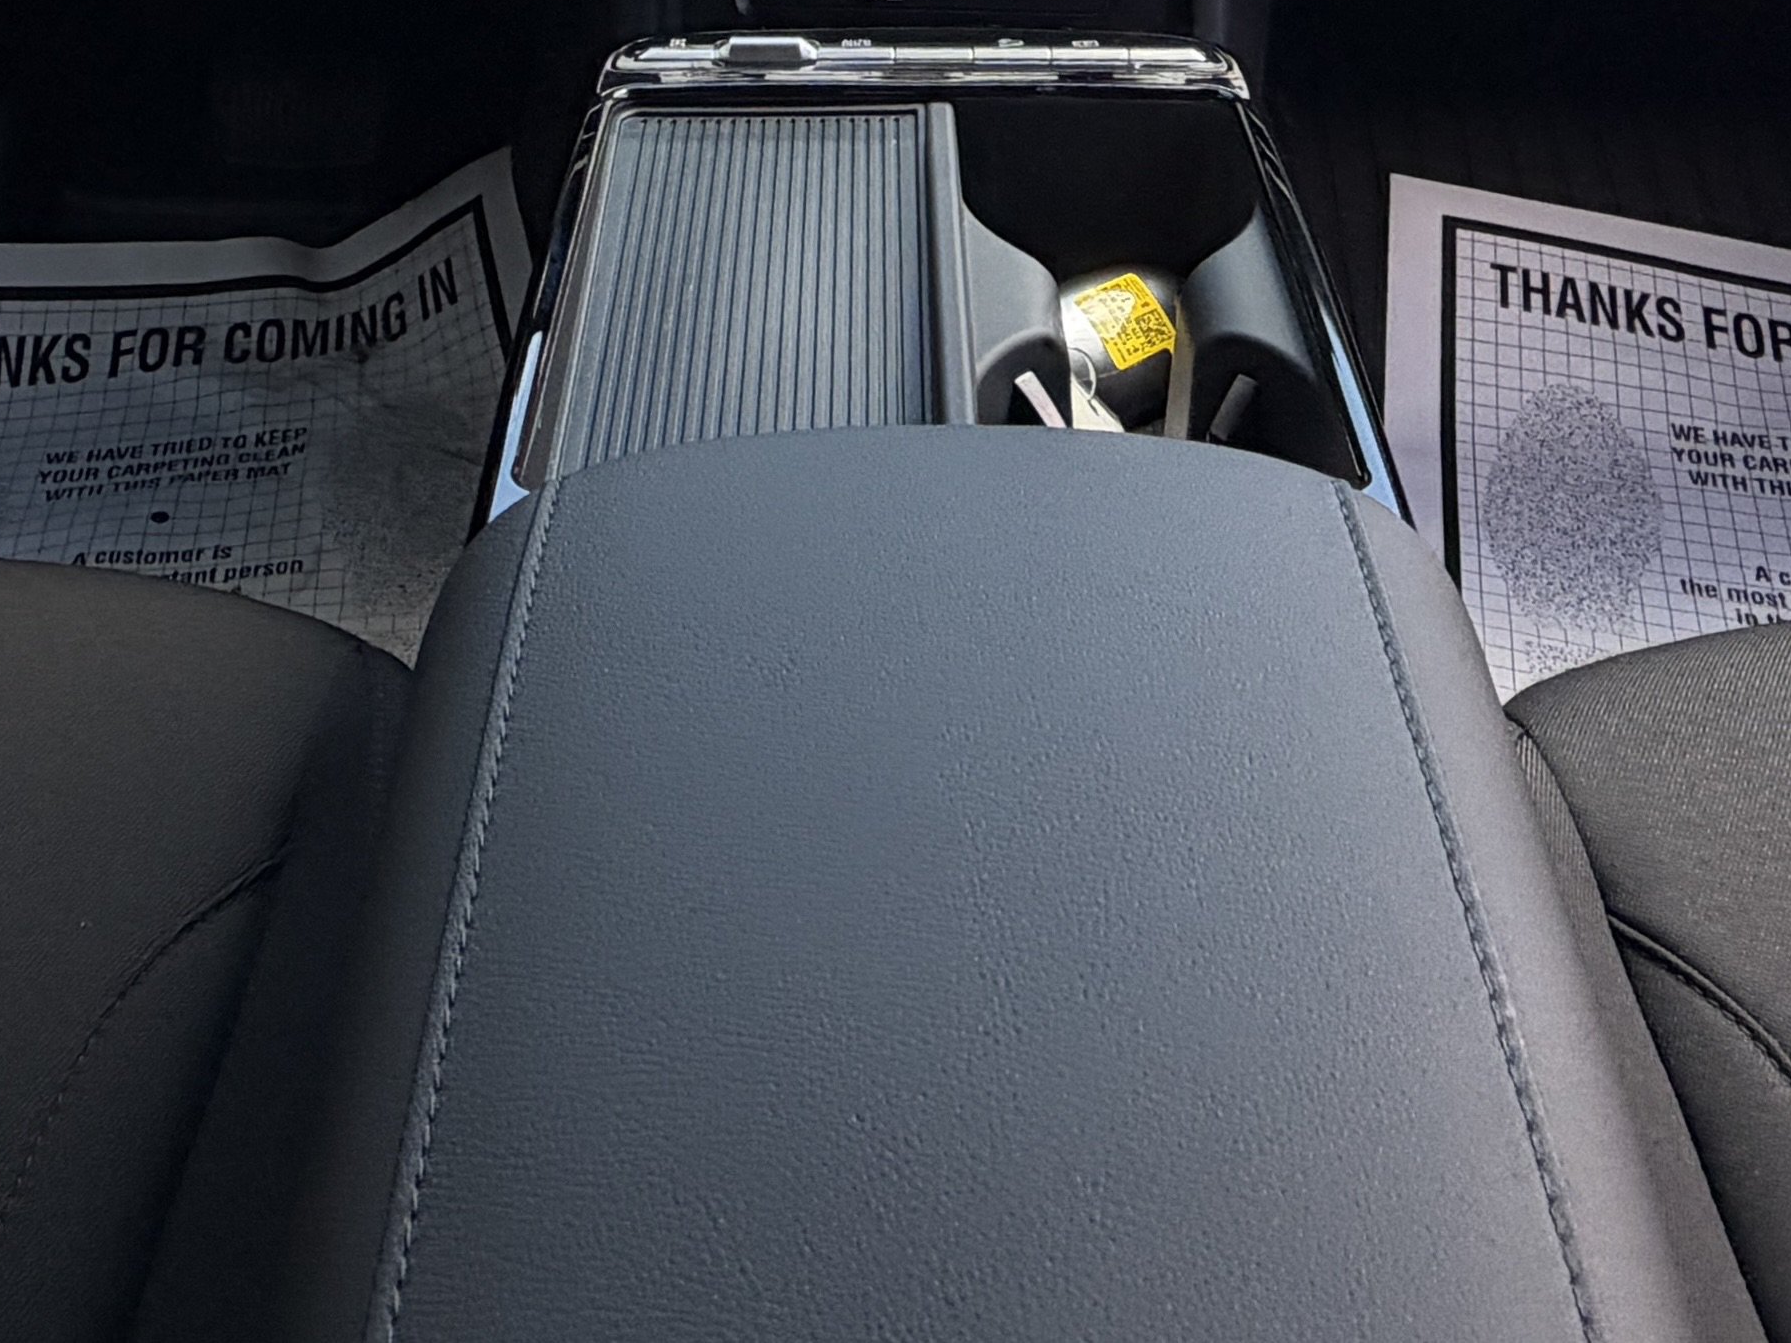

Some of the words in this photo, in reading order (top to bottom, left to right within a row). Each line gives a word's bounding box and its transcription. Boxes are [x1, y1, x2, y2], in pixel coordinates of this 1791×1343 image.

[1490, 263, 1686, 343] THANKS
[109, 326, 207, 379] FOR
[224, 292, 409, 366] COMING
[418, 258, 460, 322] IN
[46, 452, 79, 464] WE
[87, 445, 144, 462] HAVE
[151, 437, 213, 456] TRIED
[221, 435, 247, 449] TO
[254, 427, 308, 447] KEEP
[1671, 423, 1705, 444] WE
[1713, 430, 1770, 450] HAVE
[39, 468, 99, 484] YOUR
[108, 452, 230, 479] CARPETING
[238, 443, 306, 464] CLEAN
[1671, 447, 1735, 468] YOUR
[45, 485, 104, 502] WITH
[113, 477, 161, 493] THIS
[170, 468, 239, 484] PAPER
[246, 463, 290, 479] MAT
[1689, 472, 1748, 493] WITH
[94, 548, 206, 565] customer
[212, 545, 232, 560] is
[223, 559, 303, 584] person
[1755, 566, 1769, 582] A
[1680, 579, 1717, 599] the
[1728, 587, 1788, 610] most
